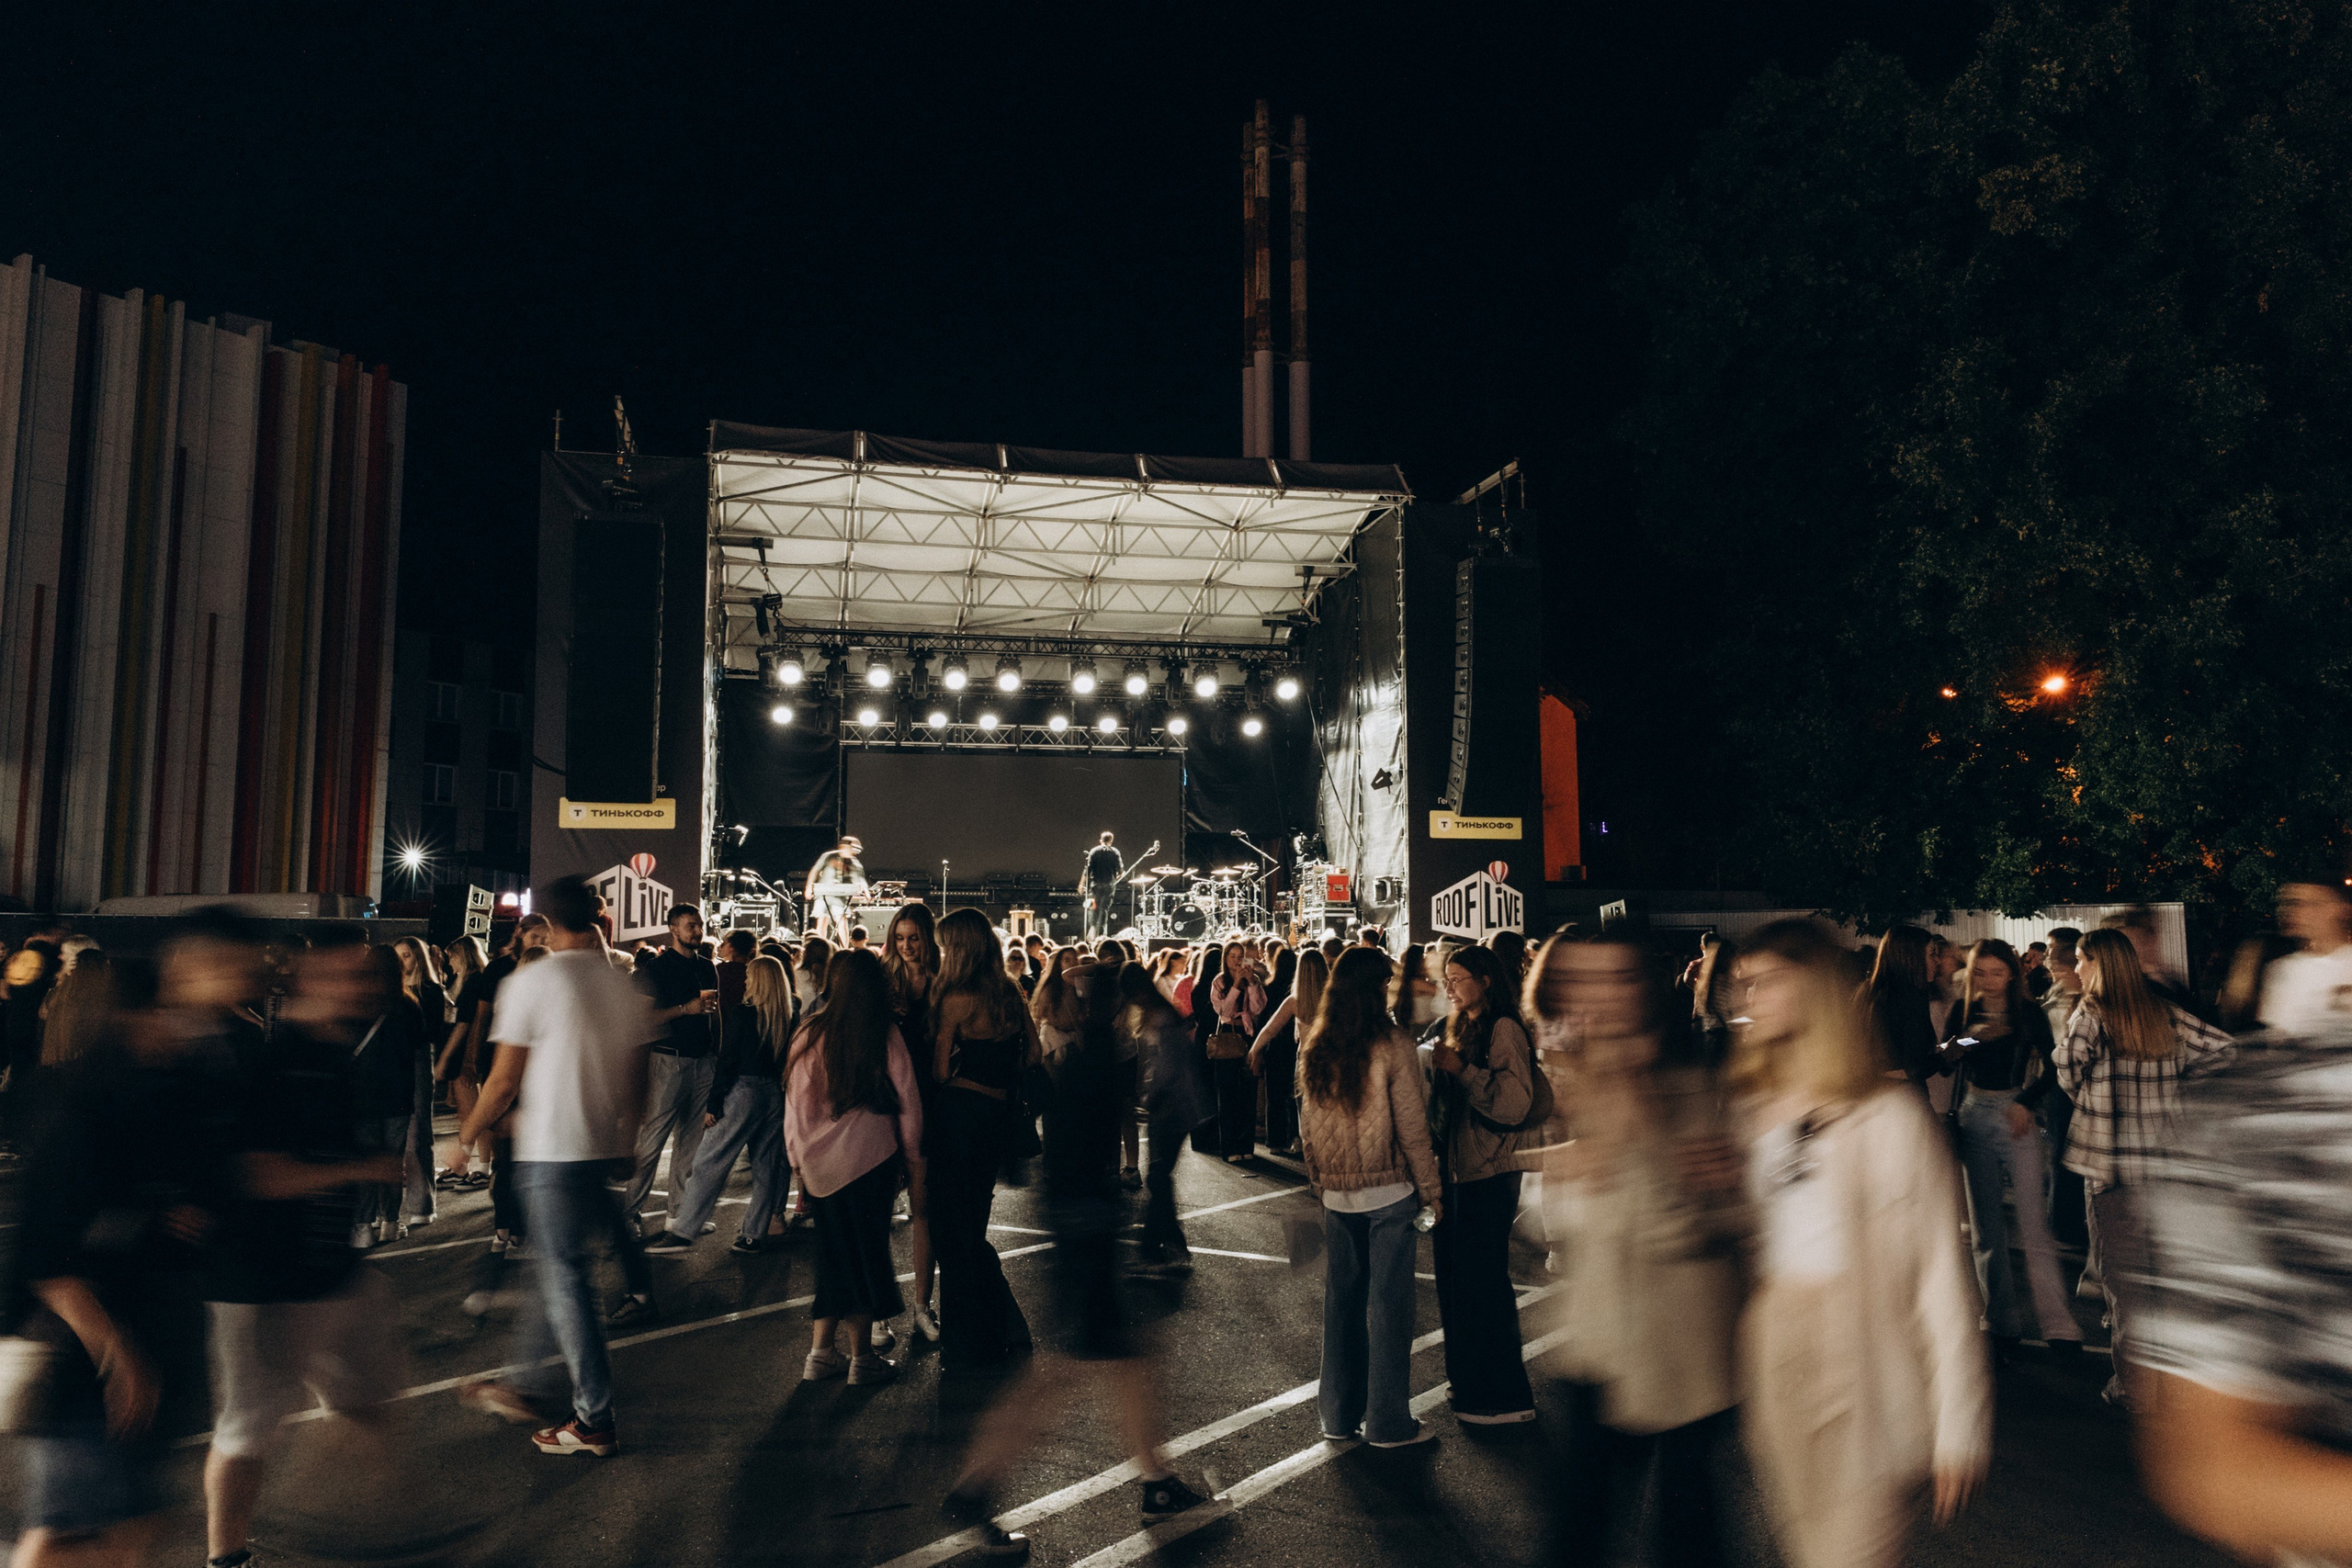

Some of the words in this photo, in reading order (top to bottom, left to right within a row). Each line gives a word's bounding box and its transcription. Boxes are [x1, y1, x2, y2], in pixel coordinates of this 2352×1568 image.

[591, 809, 665, 818] ТИНЬКОФФ
[1454, 821, 1514, 829] ТИНЬКОФФ
[1435, 880, 1478, 929] ROOF
